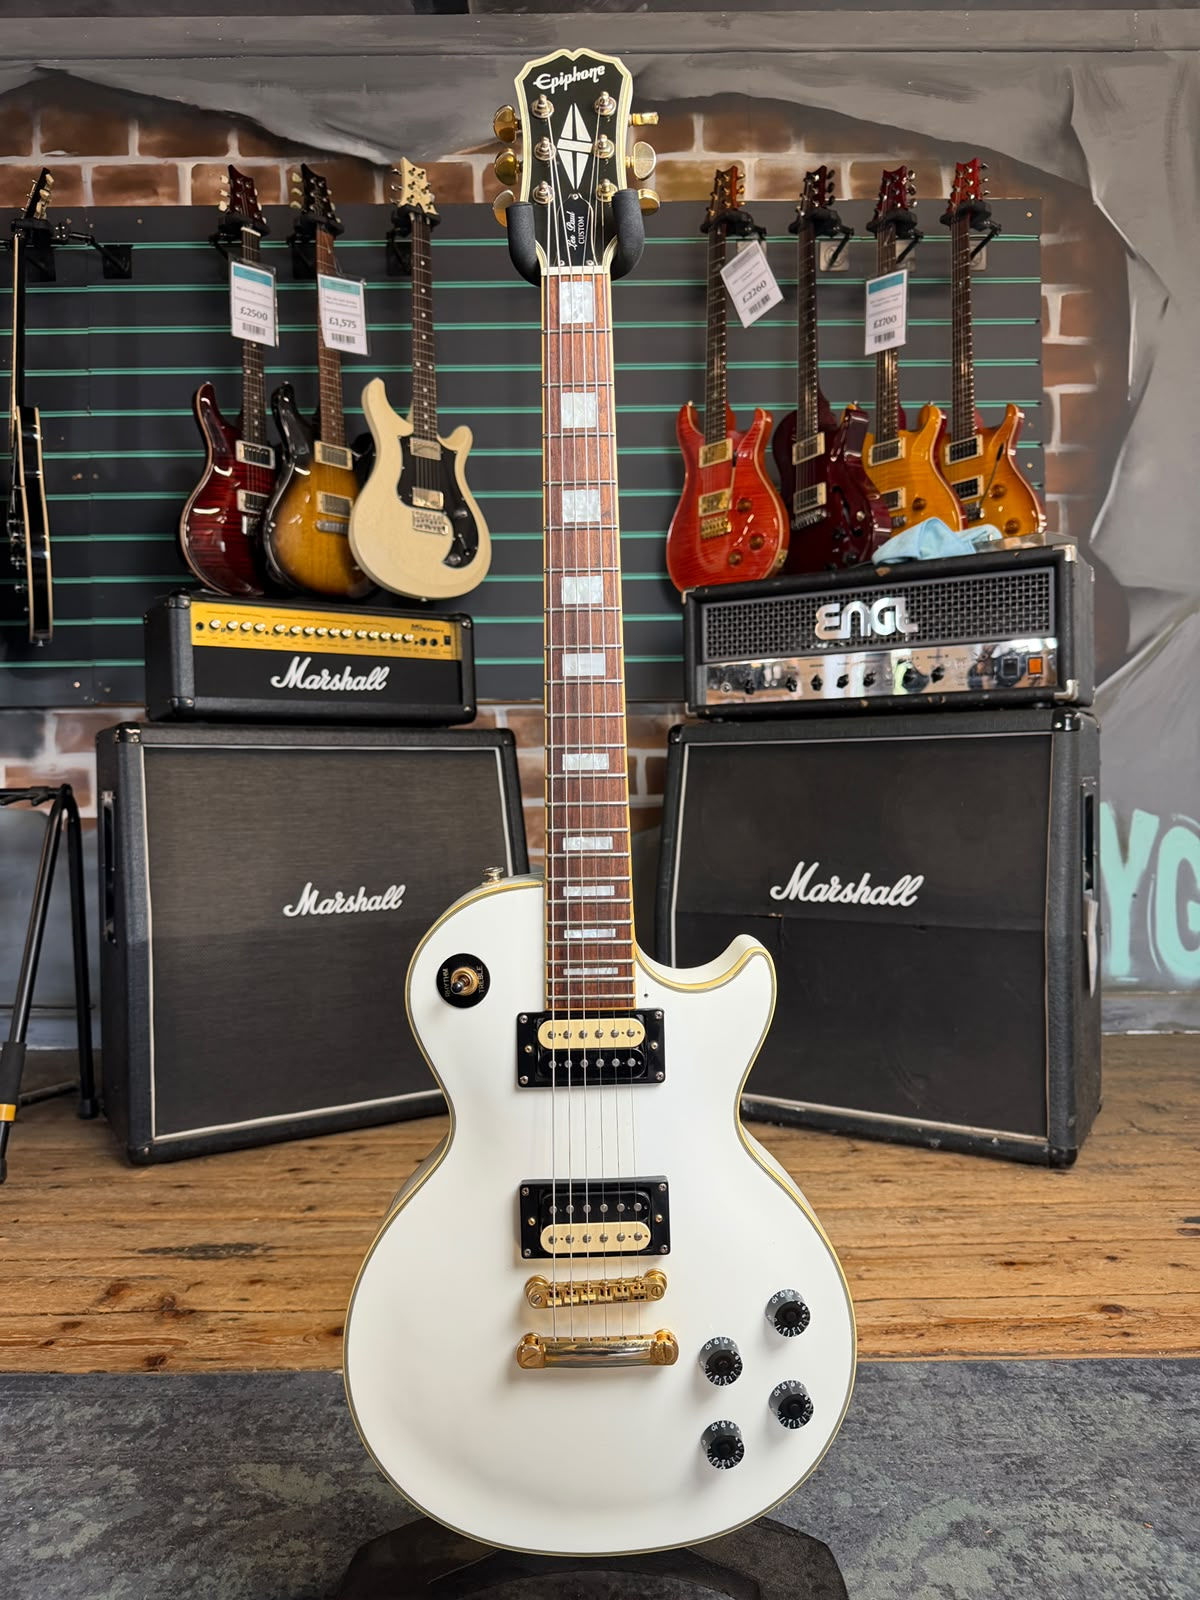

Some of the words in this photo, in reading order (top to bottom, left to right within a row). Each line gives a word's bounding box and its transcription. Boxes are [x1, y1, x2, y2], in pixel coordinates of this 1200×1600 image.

[532, 65, 605, 94] Epiphone
[240, 306, 268, 321] £2500
[814, 597, 919, 642] ENGL
[270, 656, 390, 691] Marshall
[283, 882, 406, 917] Marshall
[769, 861, 925, 907] Marshall
